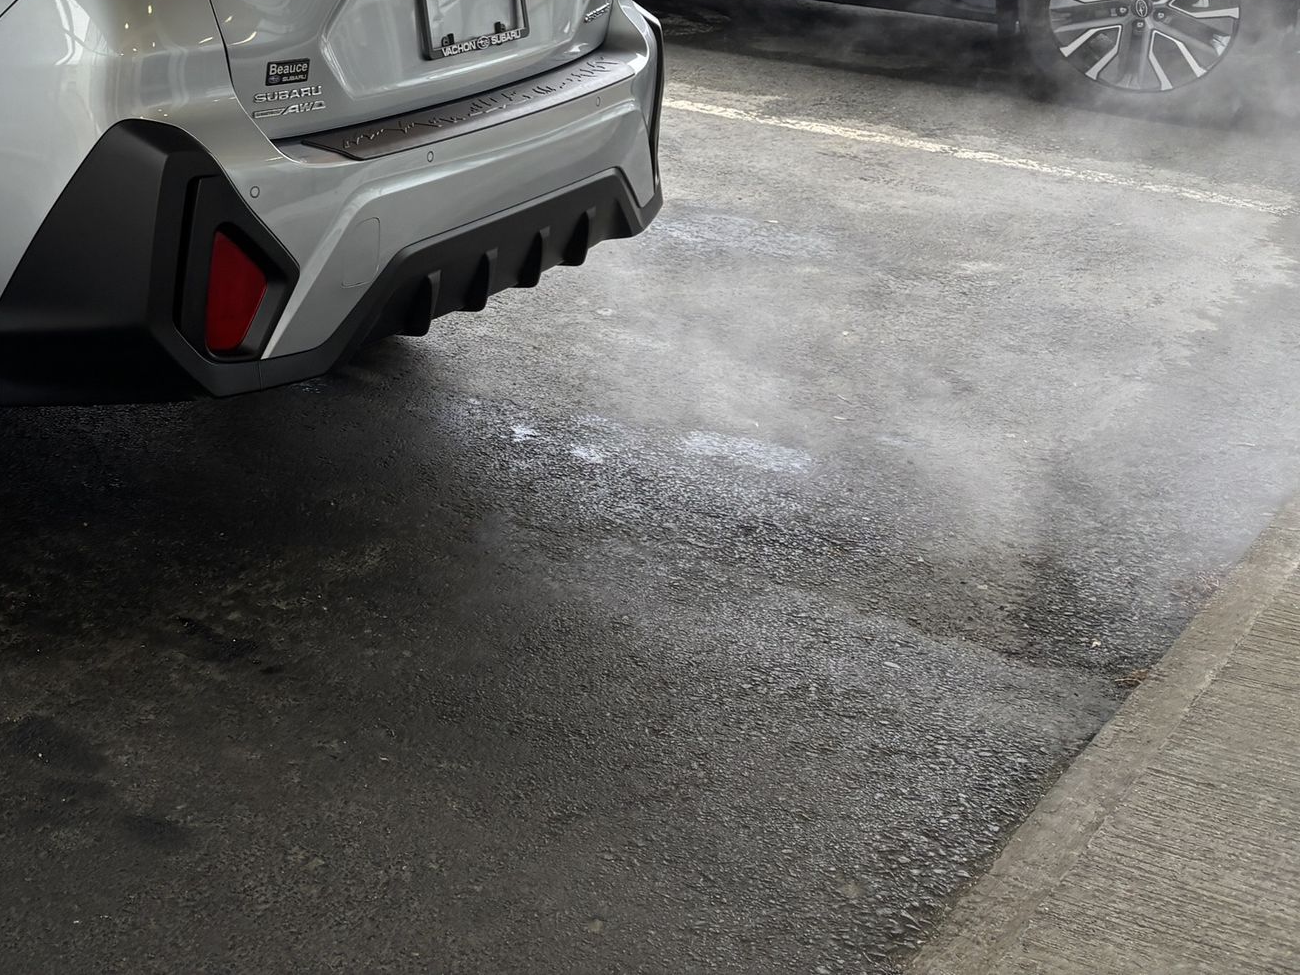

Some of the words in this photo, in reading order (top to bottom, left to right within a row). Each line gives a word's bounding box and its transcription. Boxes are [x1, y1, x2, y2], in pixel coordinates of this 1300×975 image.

[441, 40, 477, 57] VACHON
[491, 29, 521, 45] SUBARU
[269, 63, 308, 76] Beauce
[282, 74, 307, 82] SUBARU
[254, 85, 322, 103] SUBARU
[282, 100, 326, 116] AWD
